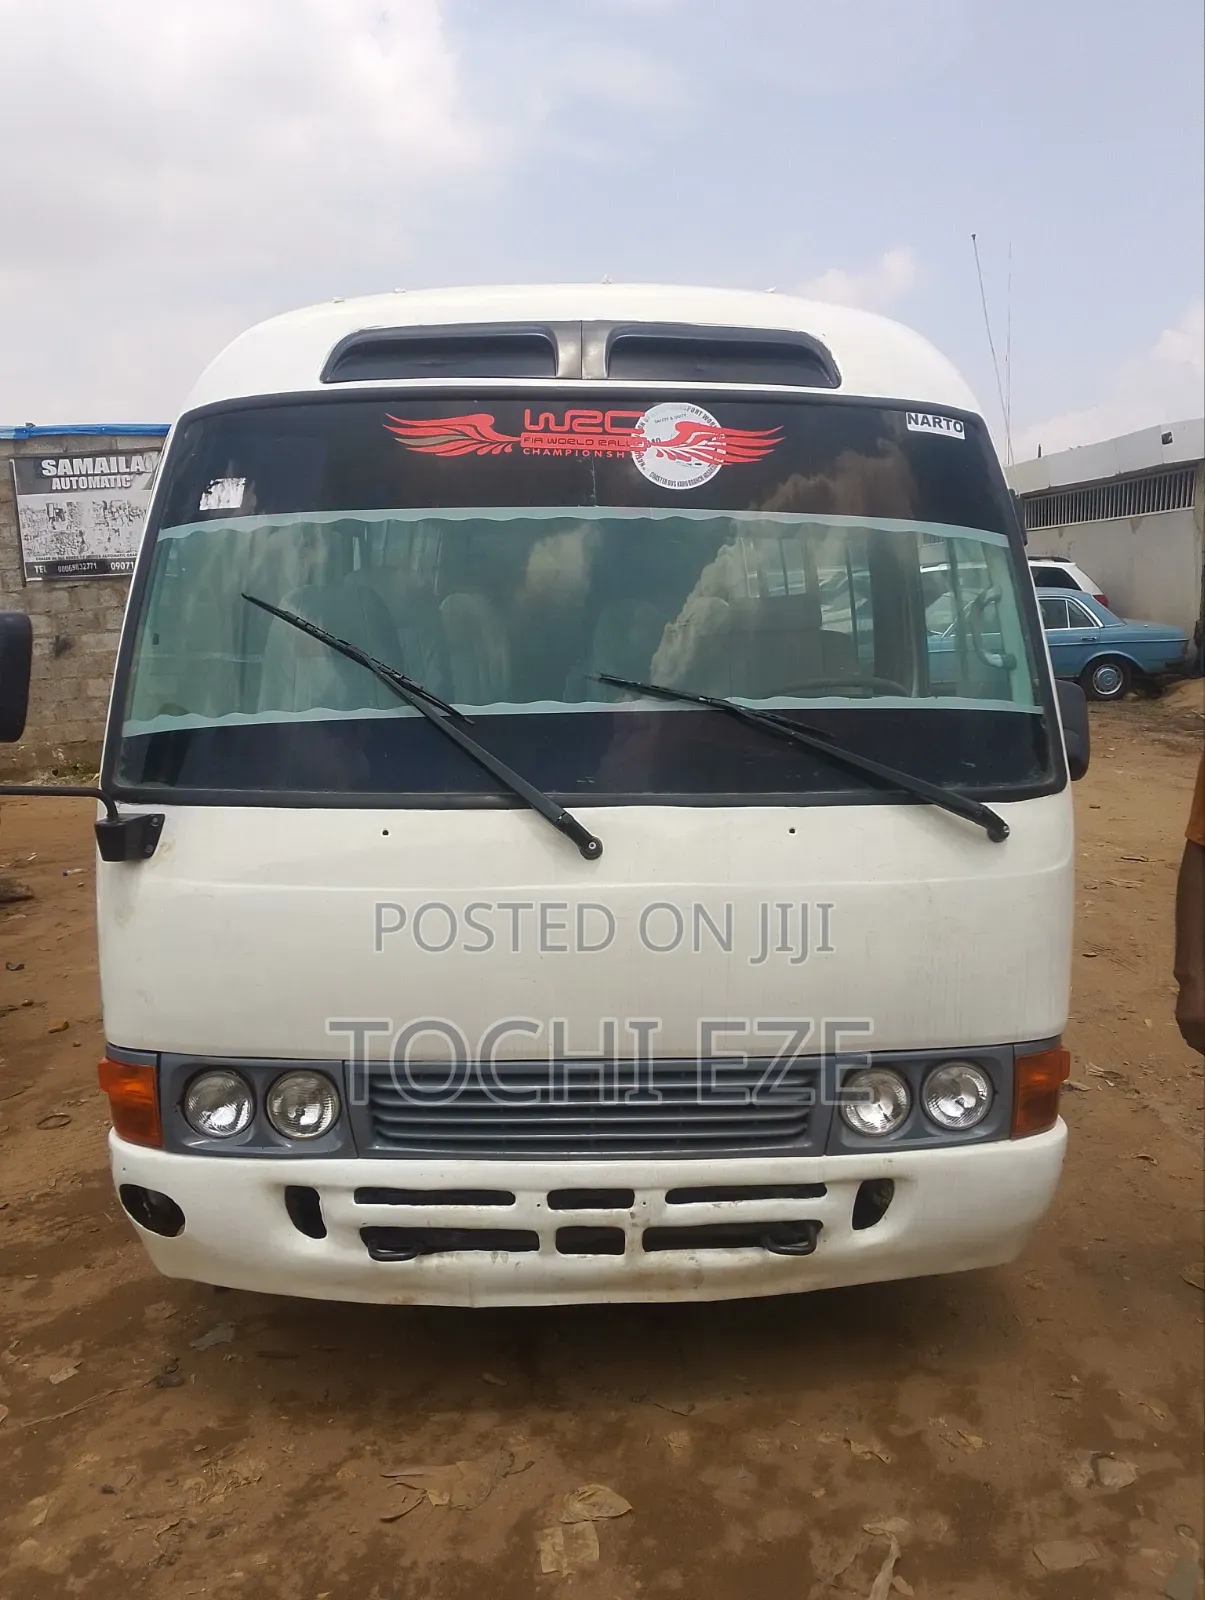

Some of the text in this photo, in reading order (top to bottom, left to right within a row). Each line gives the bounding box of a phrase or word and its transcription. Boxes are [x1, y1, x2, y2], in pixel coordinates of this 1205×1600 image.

[524, 409, 645, 434] WRC
[907, 413, 964, 433] NARTO
[547, 438, 594, 446] WORLD
[41, 456, 145, 476] SAMAILA
[52, 475, 131, 490] AUTOMATIC
[34, 565, 47, 573] TEL
